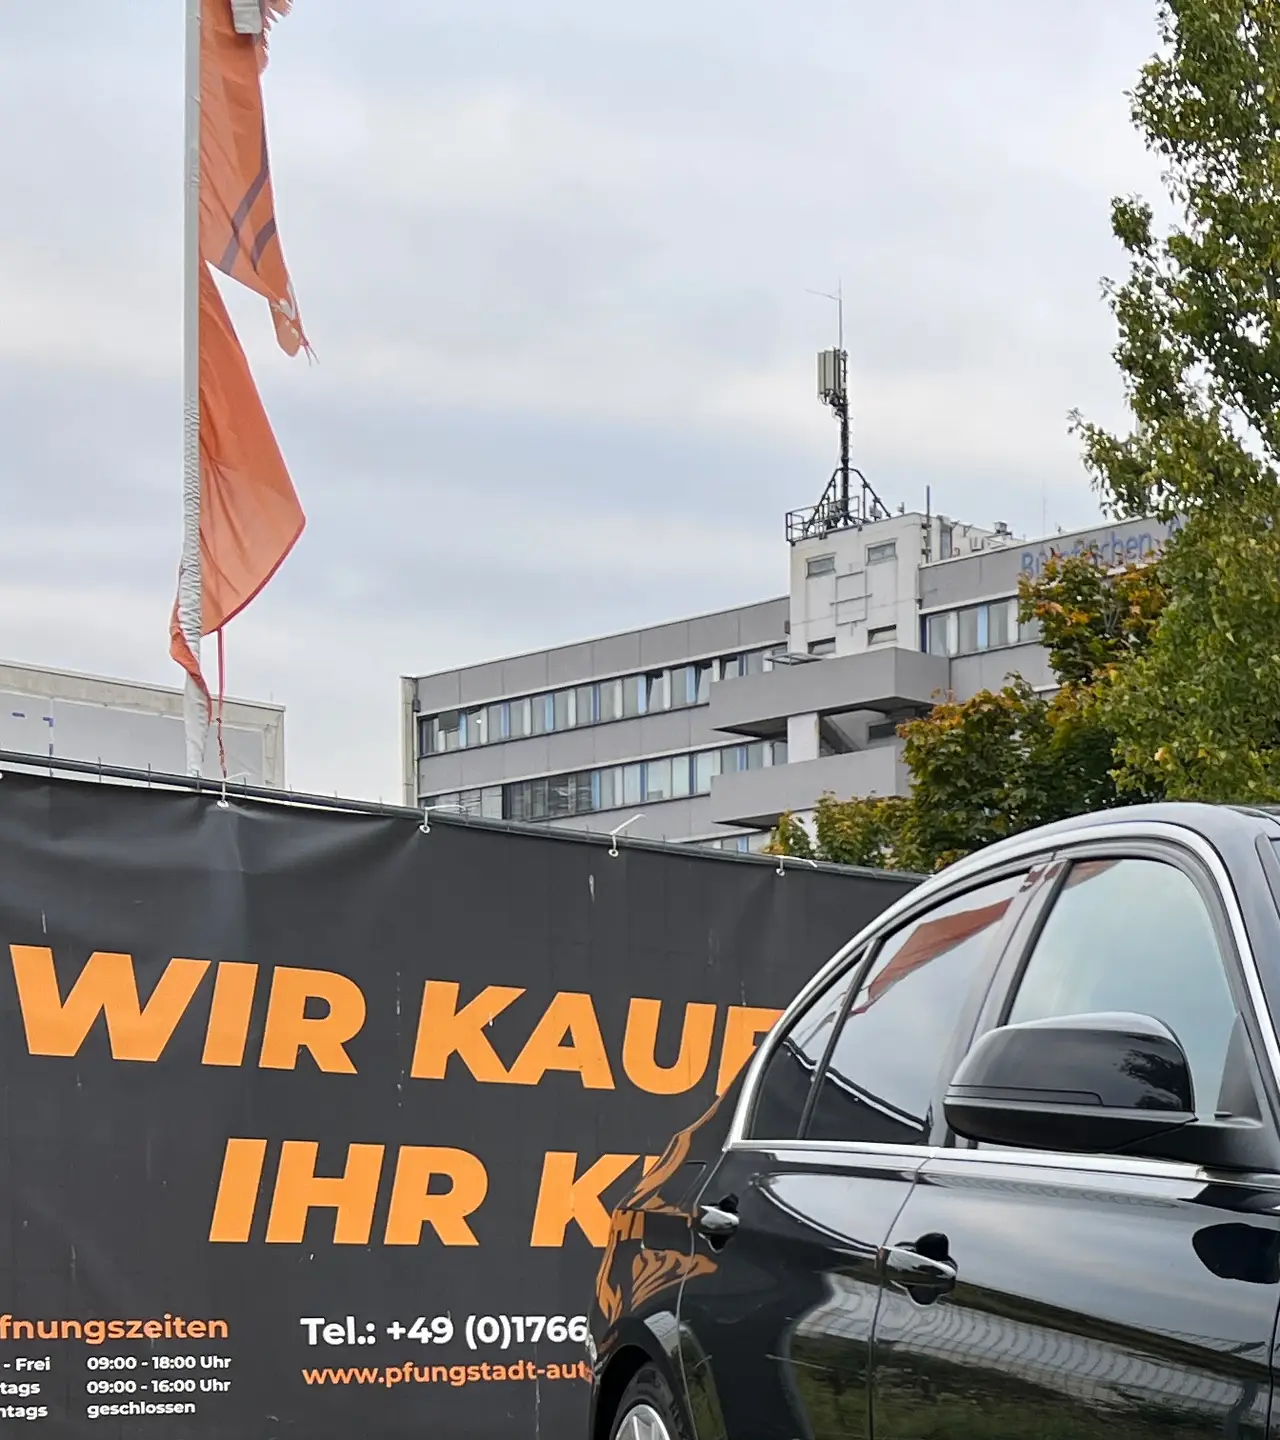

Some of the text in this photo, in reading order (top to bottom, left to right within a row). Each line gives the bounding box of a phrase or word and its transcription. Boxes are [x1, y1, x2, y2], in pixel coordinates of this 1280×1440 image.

[9, 944, 366, 1074] WIR
[208, 1138, 660, 1248] IHR K
[299, 1314, 587, 1350] Tel.: +49 (0)1766
[15, 1356, 51, 1372] Frei
[86, 1356, 137, 1370] 09:00
[151, 1355, 196, 1370] 18:00
[200, 1354, 232, 1369] Uhr
[86, 1380, 137, 1394] 09:00
[150, 1379, 196, 1394] 16:00
[199, 1378, 232, 1392] Uhr
[87, 1401, 196, 1419] geschlossen
